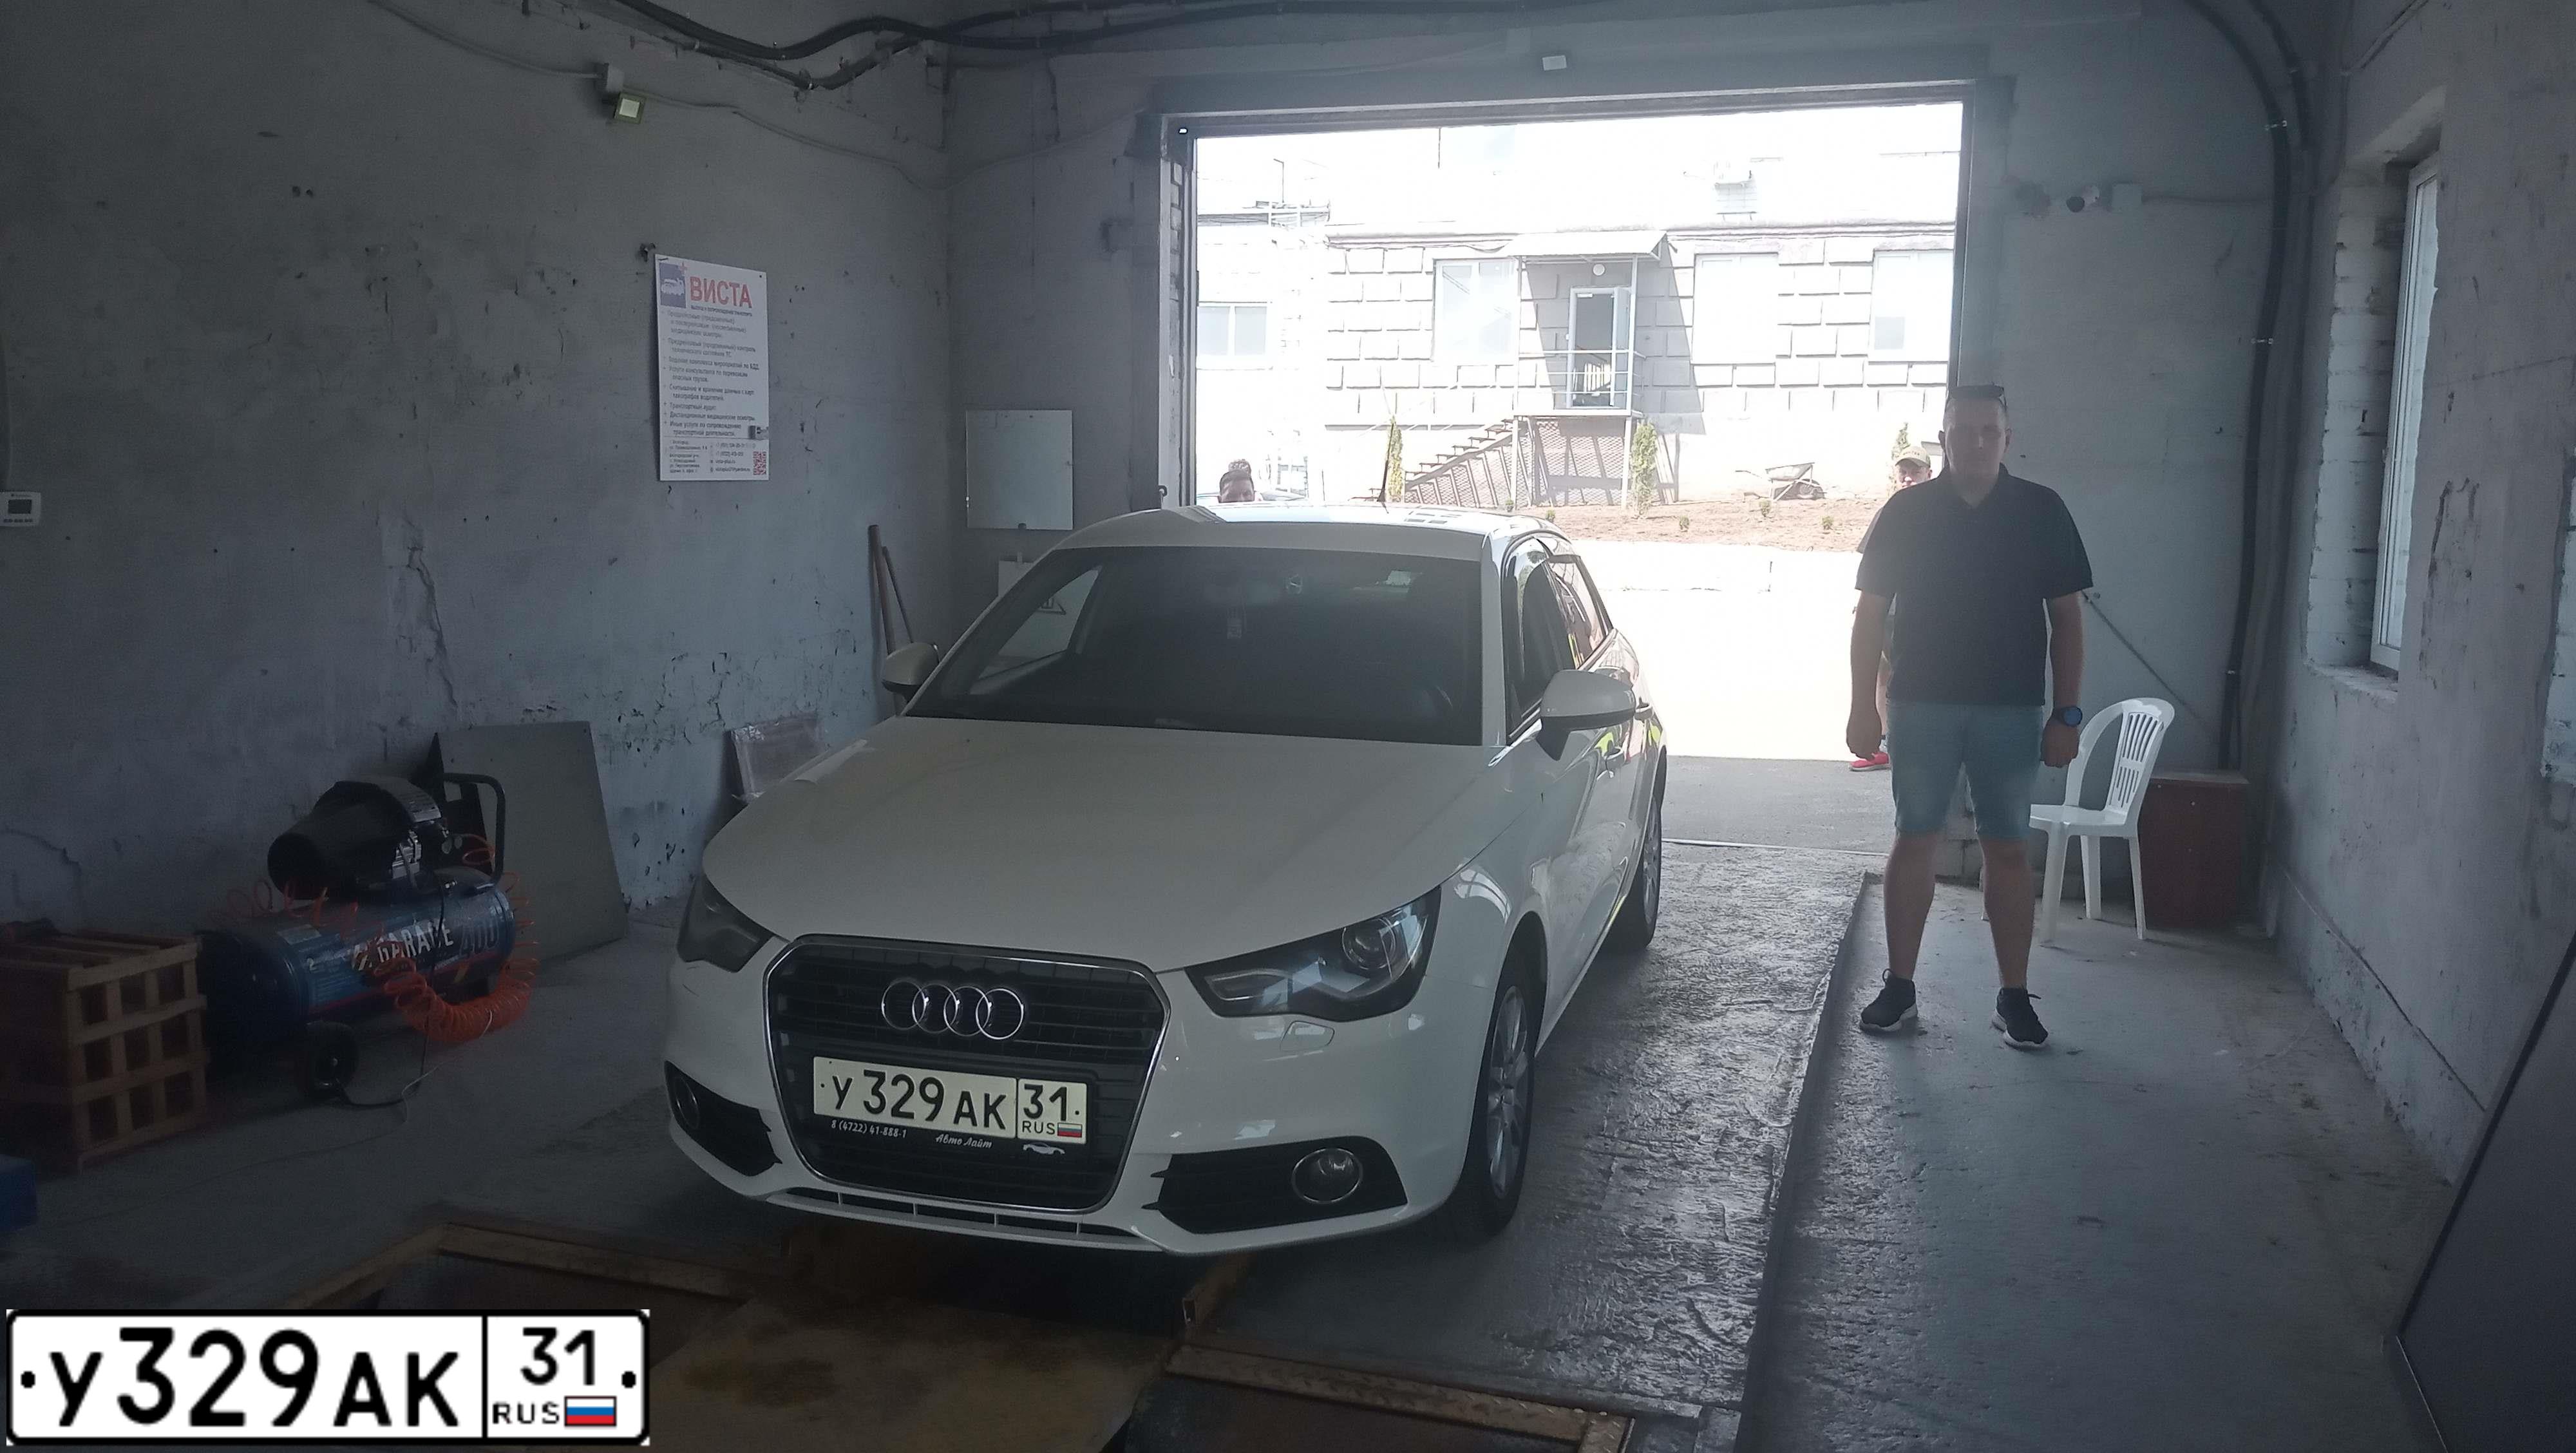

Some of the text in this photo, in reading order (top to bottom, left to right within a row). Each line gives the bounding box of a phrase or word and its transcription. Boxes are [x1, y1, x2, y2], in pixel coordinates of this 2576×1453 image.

[690, 276, 752, 309] ВИСТА
[1023, 1083, 1067, 1121] 31
[831, 1119, 907, 1138] 8 (4722) 41-888-1
[1021, 1121, 1056, 1135] RUS
[935, 1133, 992, 1149] Авто Лайт
